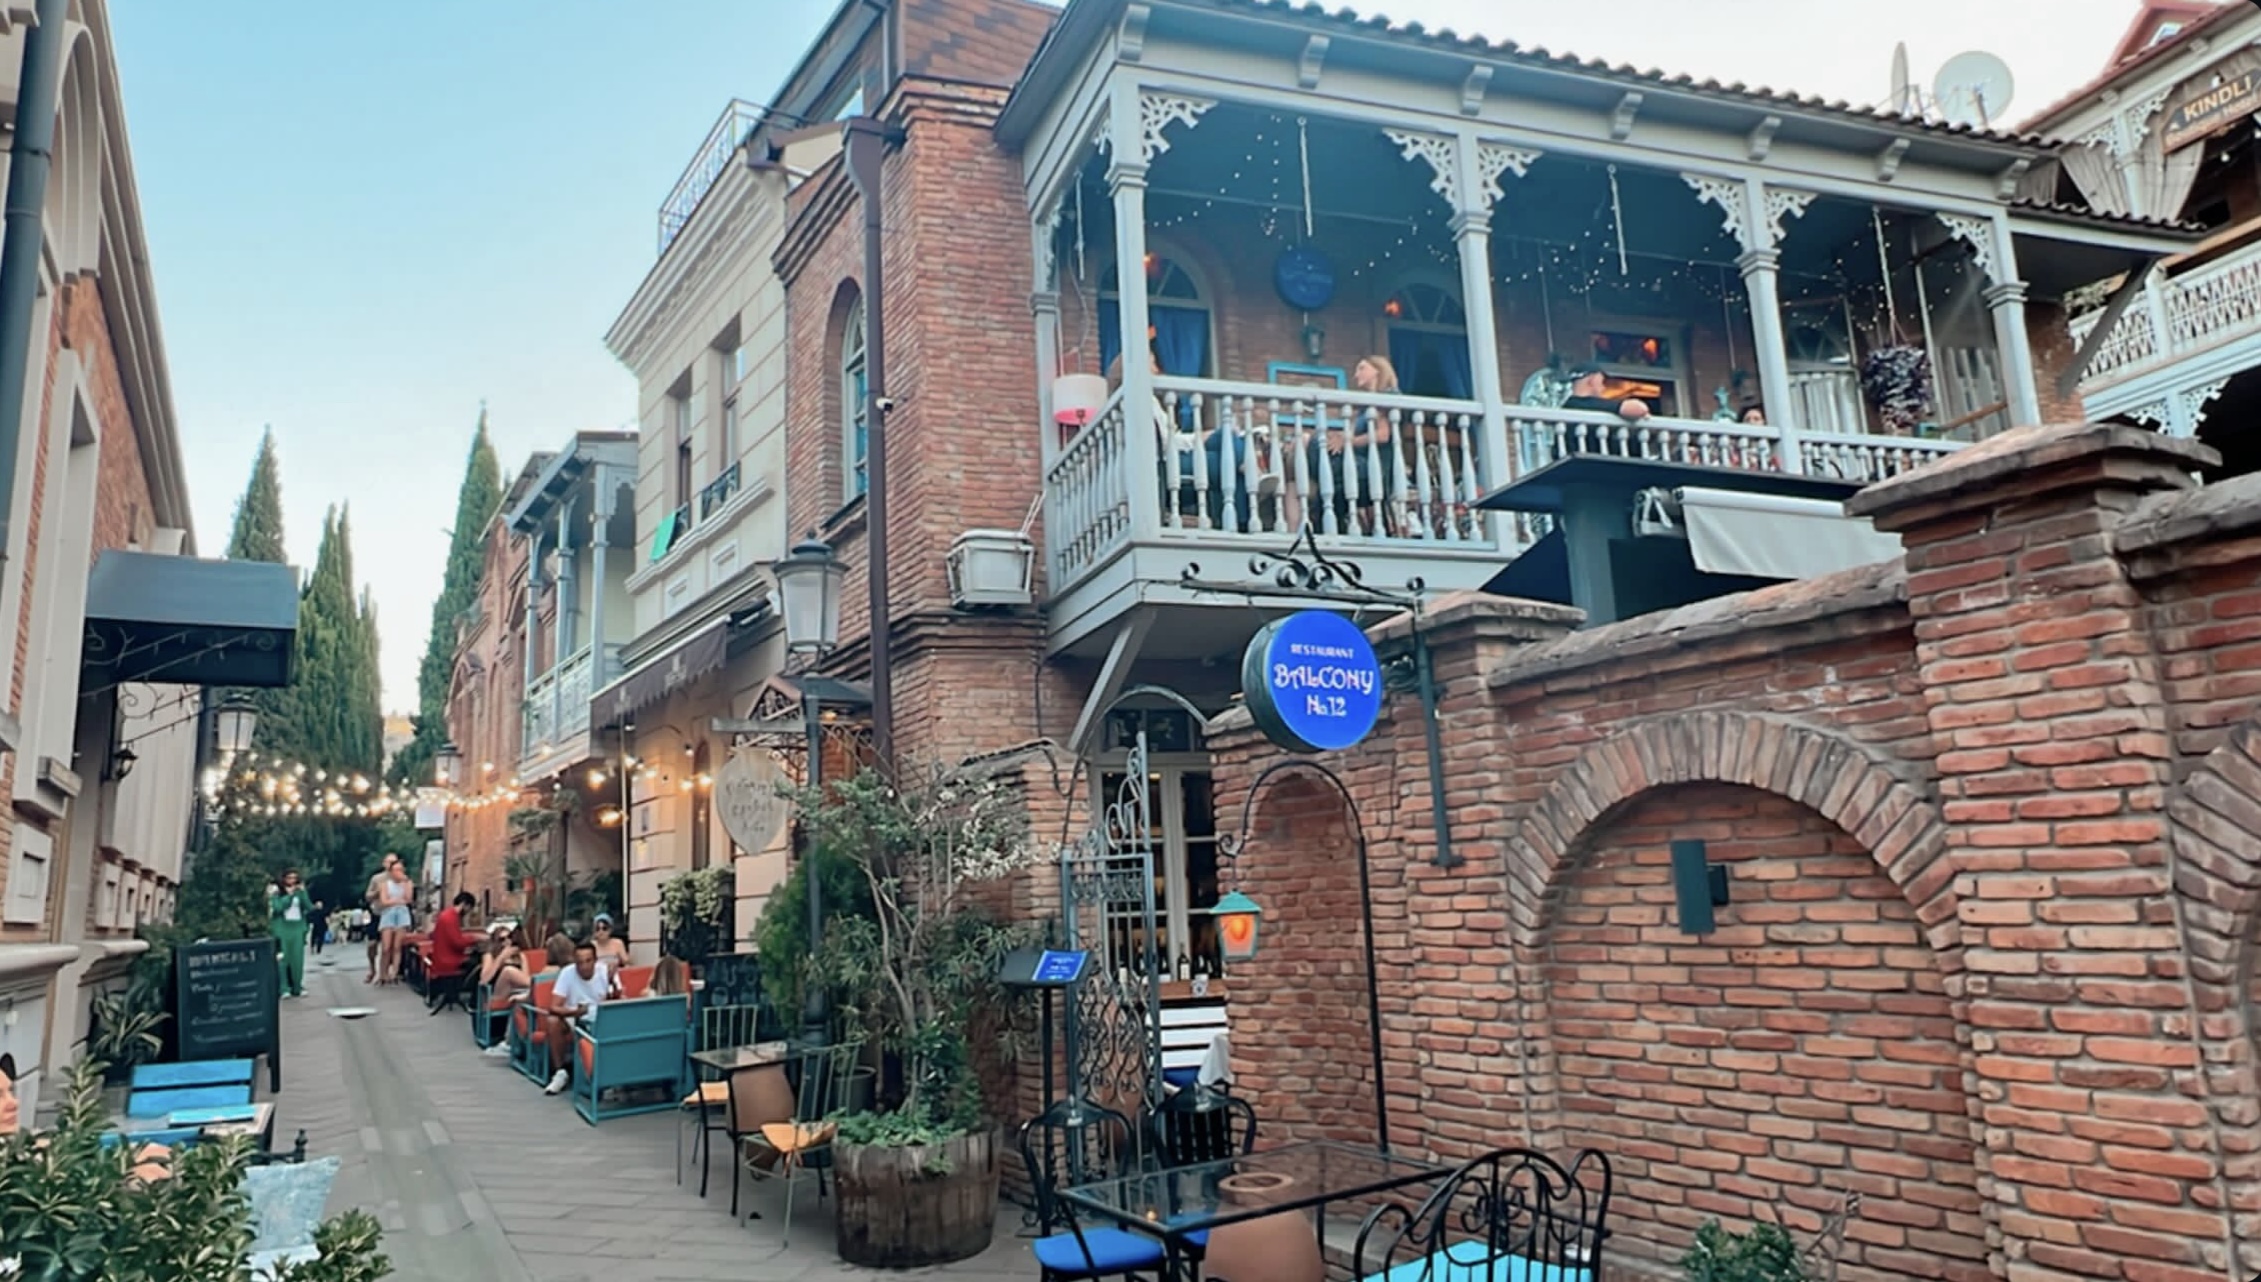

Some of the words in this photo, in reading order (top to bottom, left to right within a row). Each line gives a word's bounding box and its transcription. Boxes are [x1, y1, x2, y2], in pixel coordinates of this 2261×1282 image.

[2184, 75, 2252, 122] KINDLI
[1291, 643, 1354, 658] RESTAURANT
[1274, 664, 1373, 694] BALCONY
